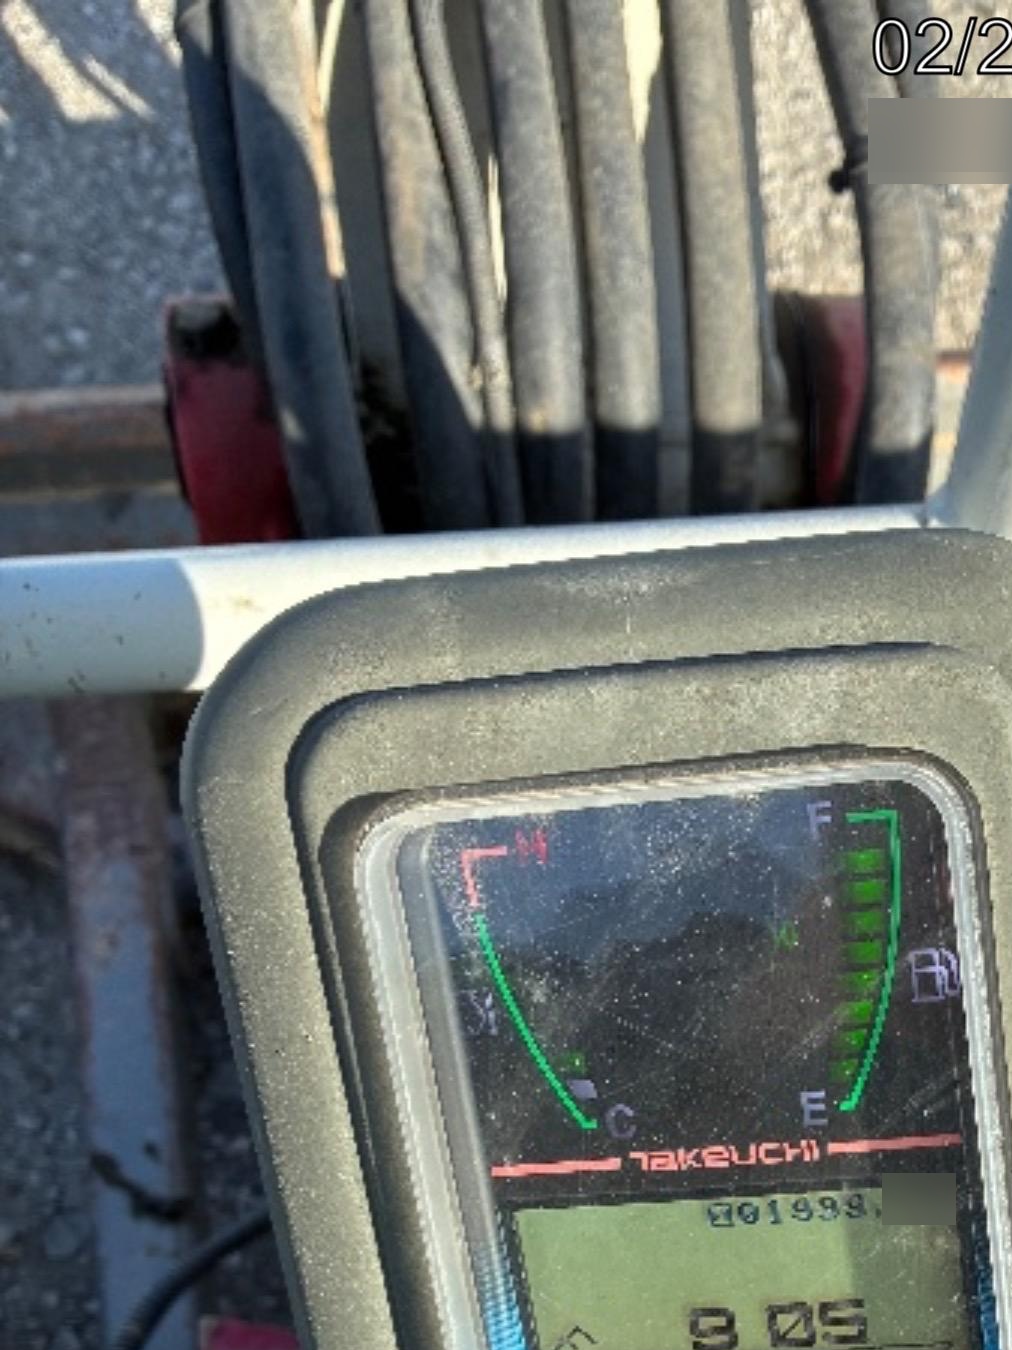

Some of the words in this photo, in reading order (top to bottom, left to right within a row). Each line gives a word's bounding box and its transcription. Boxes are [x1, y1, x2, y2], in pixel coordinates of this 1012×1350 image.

[806, 801, 832, 841] F
[605, 1103, 637, 1139] C
[800, 1089, 828, 1127] E
